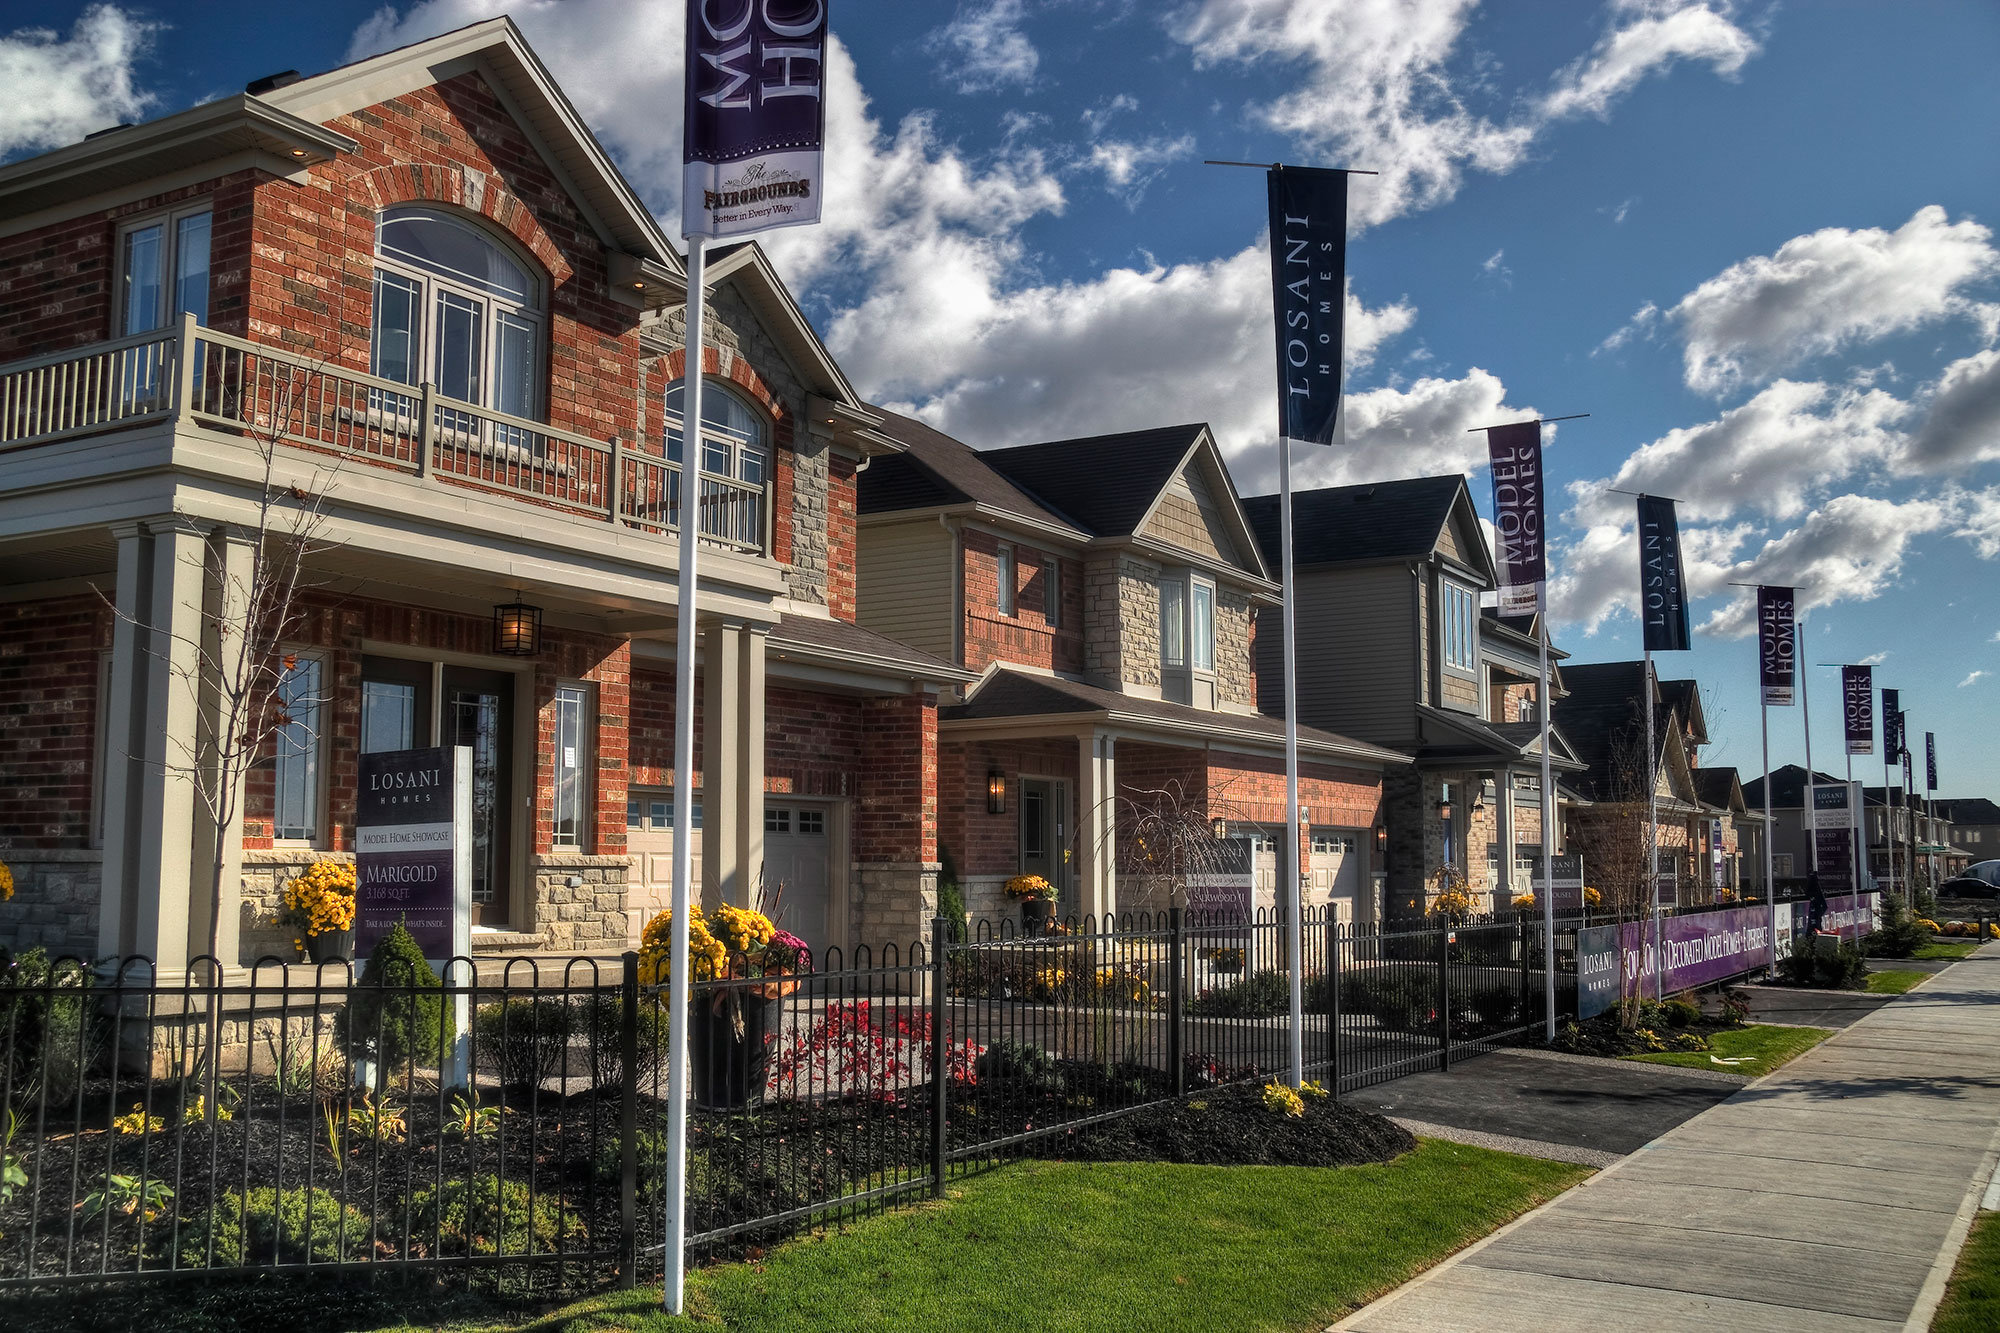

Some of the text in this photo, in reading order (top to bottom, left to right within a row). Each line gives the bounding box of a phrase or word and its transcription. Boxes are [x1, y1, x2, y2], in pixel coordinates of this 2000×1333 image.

[741, 162, 768, 185] The
[703, 179, 811, 211] FAIRGROUNDS
[713, 204, 793, 224] Better in Every Way.
[1284, 213, 1310, 399] LOSANI
[1318, 241, 1333, 374] HOMES
[1491, 447, 1523, 566] MODEL
[1518, 447, 1538, 565] HOMES
[1645, 522, 1665, 627] LOSANI
[1665, 536, 1679, 611] HOMES
[1762, 599, 1776, 674] MODEL
[1778, 600, 1794, 675] HOMES
[1846, 675, 1858, 732] MODEL
[1858, 675, 1872, 731] HOMES
[371, 769, 440, 791] LOSANI
[380, 794, 431, 805] HOMES
[363, 831, 449, 845] MODEL HOME SHOWCASE
[366, 865, 438, 884] MARIGOLD
[1539, 861, 1575, 869] LSANI
[1538, 891, 1572, 899] COUSEL
[365, 919, 378, 928] TAKE
[378, 920, 384, 928] A
[384, 919, 396, 928] LOO
[1584, 951, 1613, 975] LOSANI
[1667, 938, 1703, 970] DECORATED
[1704, 933, 1723, 961] MODEL
[1723, 929, 1740, 956] HOMES
[1588, 978, 1610, 991] HOMES
